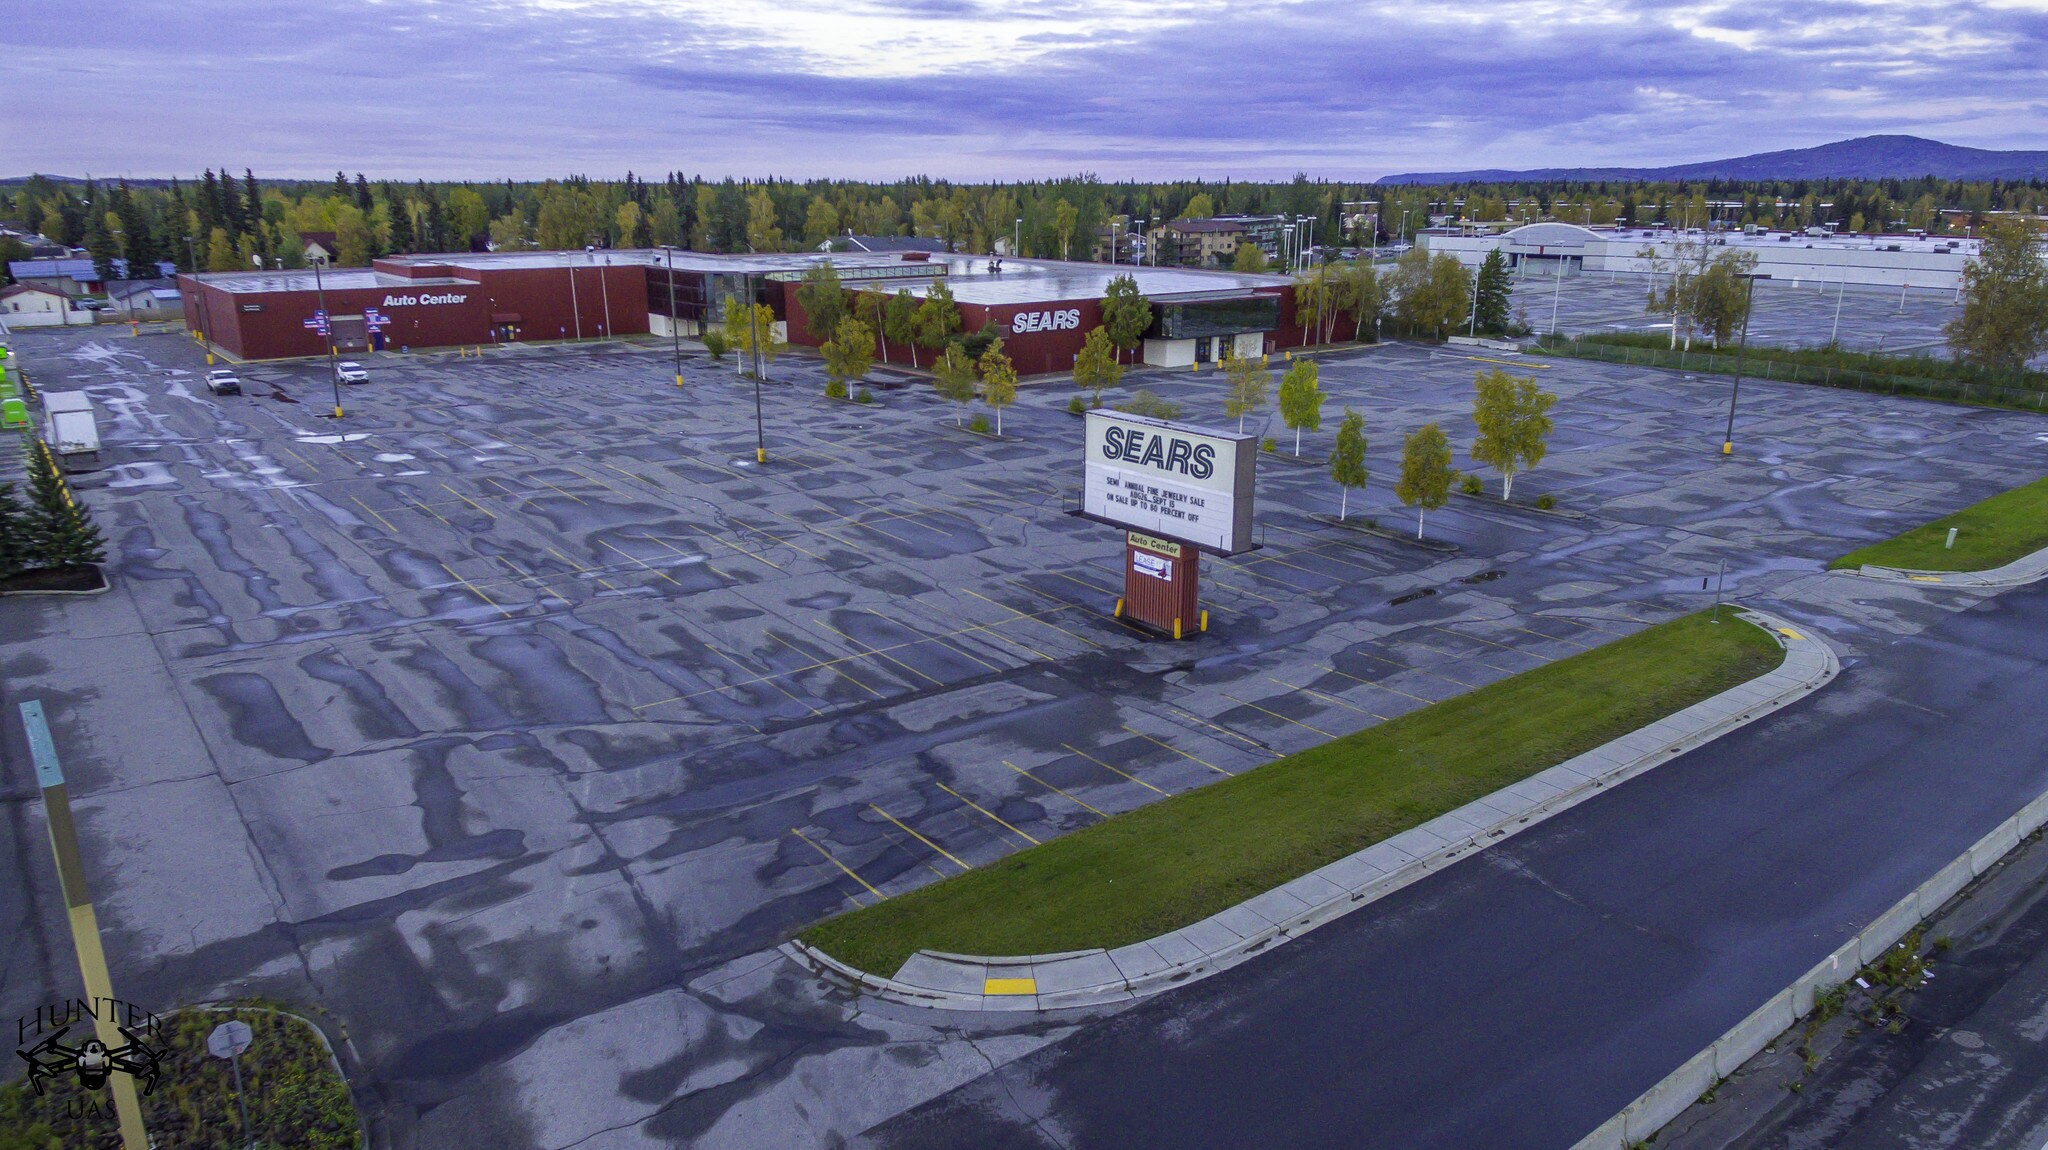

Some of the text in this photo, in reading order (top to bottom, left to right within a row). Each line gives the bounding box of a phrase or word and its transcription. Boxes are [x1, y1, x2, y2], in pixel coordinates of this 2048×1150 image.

[383, 293, 467, 306] Auto Center
[1012, 309, 1080, 333] SEARS
[1103, 425, 1216, 480] SEARS
[1124, 481, 1145, 492] ANNUAL
[1147, 486, 1159, 496] FINE
[1161, 490, 1188, 503] JEWELRY
[1190, 496, 1205, 507] SALE
[1106, 493, 1114, 501] ON
[1115, 495, 1128, 505] SALE
[1140, 501, 1148, 510] TO
[1160, 506, 1186, 519] PERCENT
[1187, 513, 1199, 522] OFF
[1130, 534, 1178, 554] Auto Center
